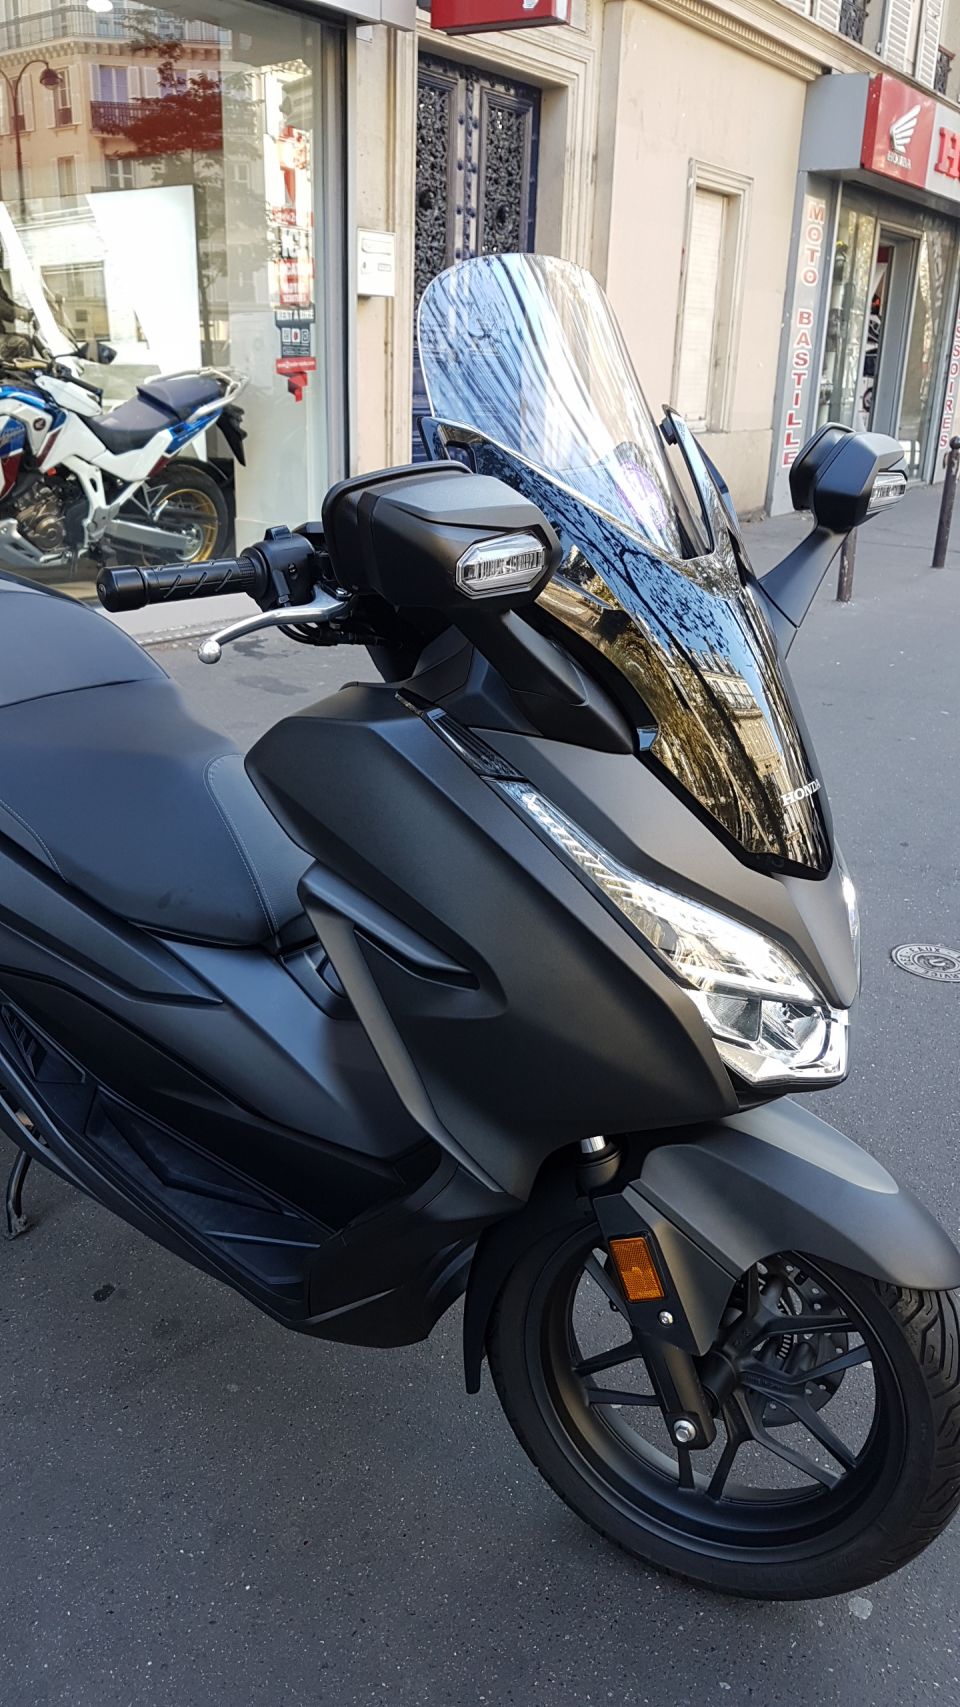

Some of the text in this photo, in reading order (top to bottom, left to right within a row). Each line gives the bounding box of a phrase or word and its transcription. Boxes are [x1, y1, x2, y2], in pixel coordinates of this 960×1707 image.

[934, 127, 960, 179] H
[783, 203, 825, 467] MOTO BASTILLE
[939, 311, 960, 447] SSOIRES
[781, 779, 821, 807] HONDA
